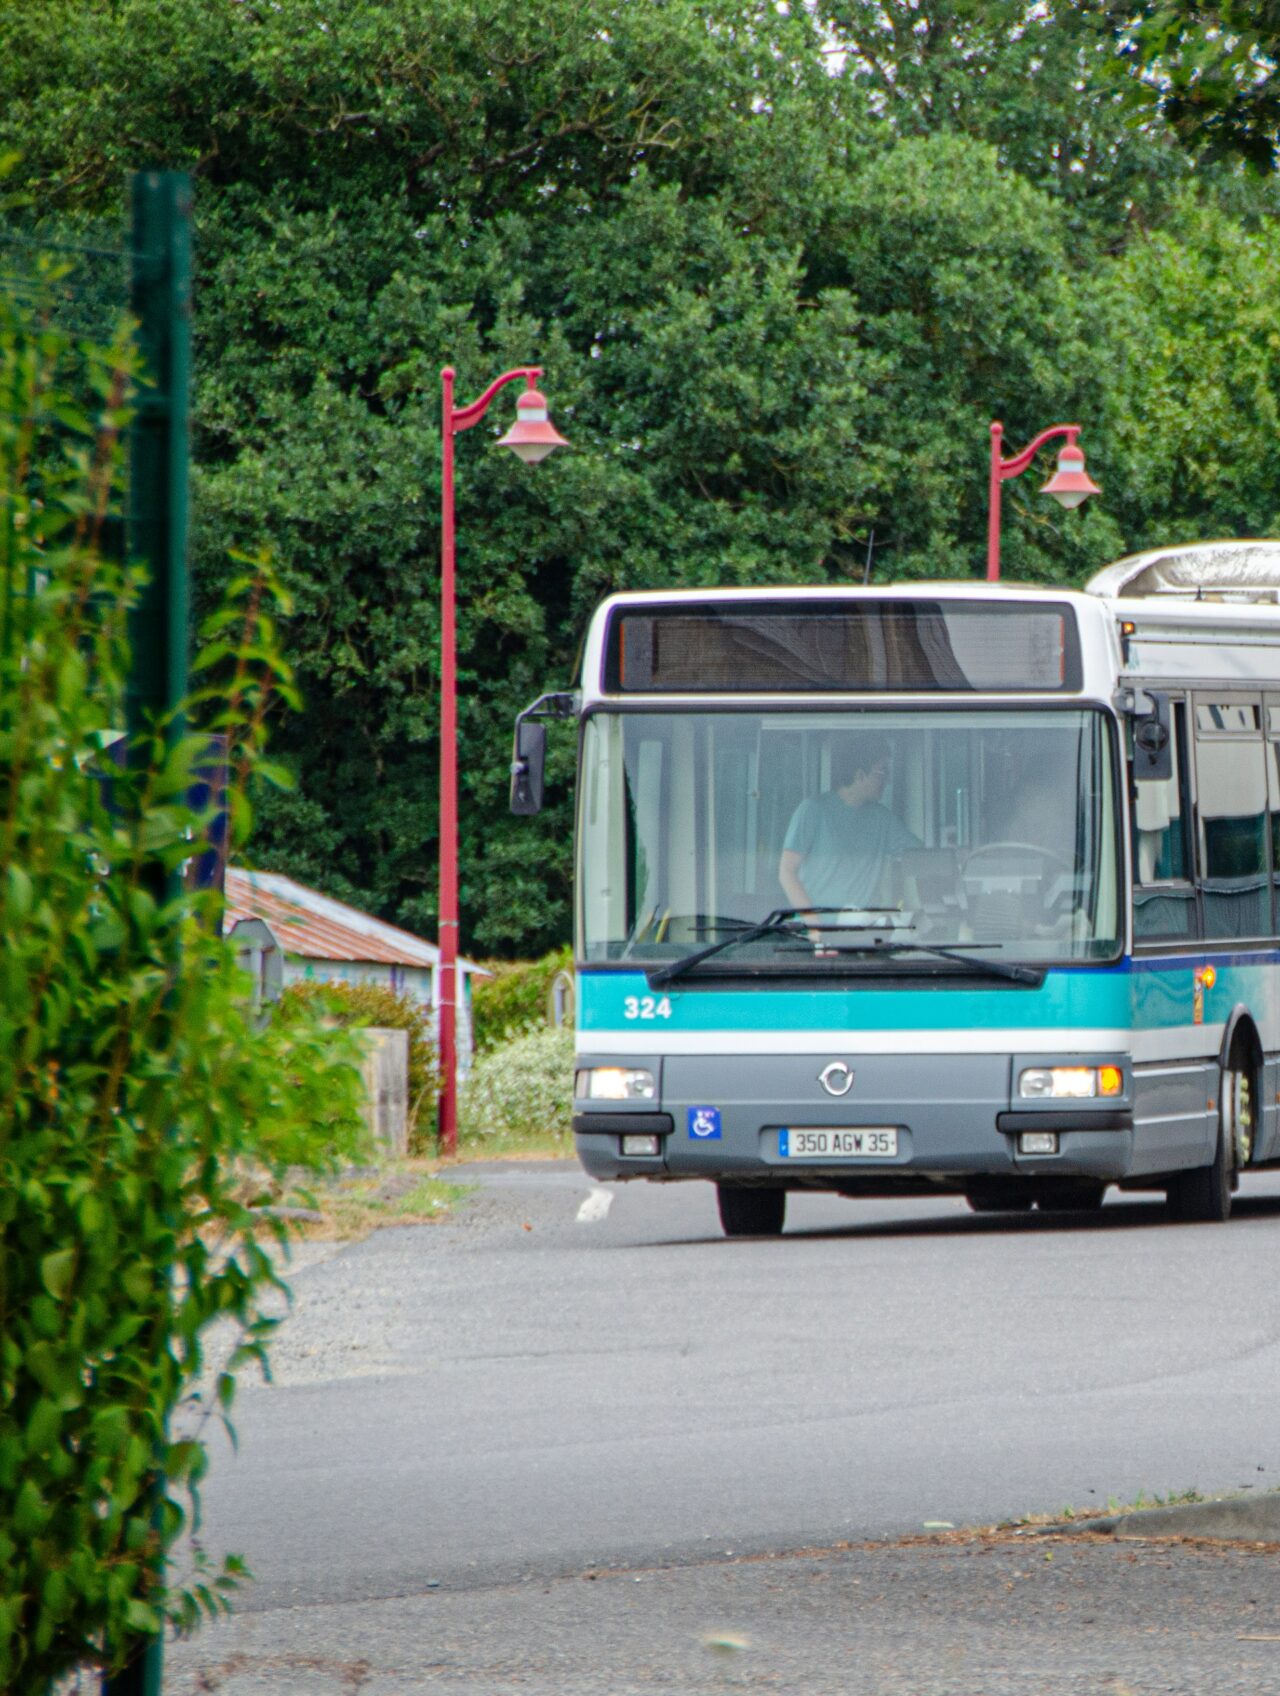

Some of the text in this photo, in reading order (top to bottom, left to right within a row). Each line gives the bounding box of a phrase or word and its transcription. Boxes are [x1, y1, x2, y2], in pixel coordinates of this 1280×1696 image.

[624, 996, 672, 1019] 324
[796, 1133, 828, 1153] 350
[832, 1133, 863, 1153] AGW
[867, 1133, 889, 1153] 35
